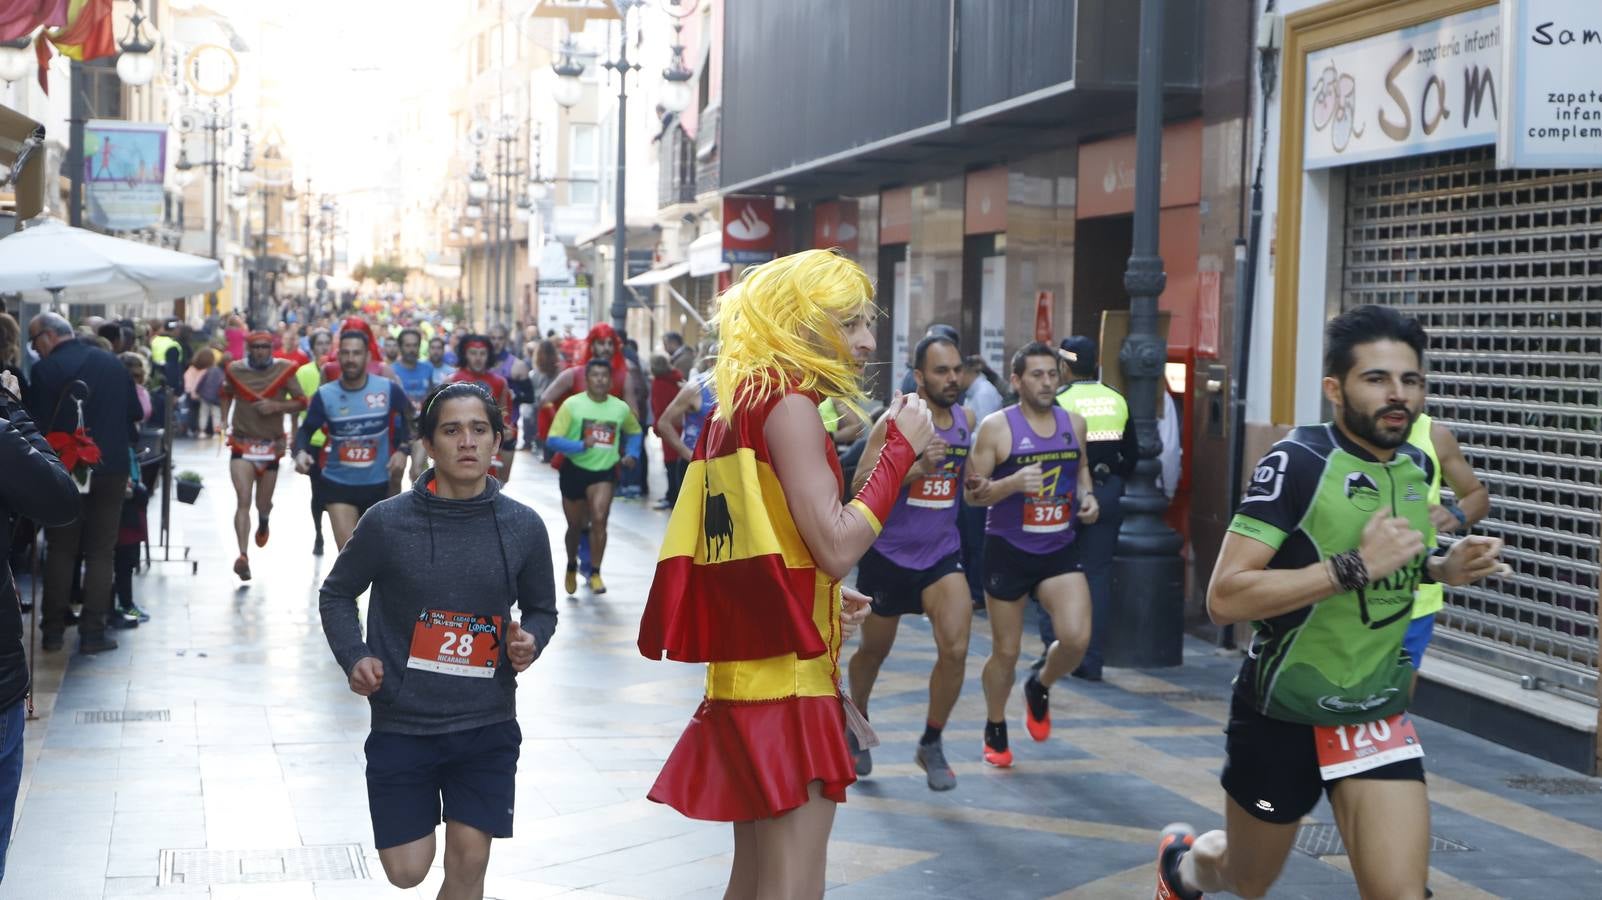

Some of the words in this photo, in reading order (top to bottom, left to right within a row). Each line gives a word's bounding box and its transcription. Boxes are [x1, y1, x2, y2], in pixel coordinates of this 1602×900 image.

[1464, 26, 1500, 53] infantil
[1532, 22, 1602, 45] Sam
[1378, 46, 1498, 141] Sam
[1557, 107, 1601, 120] infan
[1528, 125, 1602, 142] complem
[346, 448, 370, 459] 472
[922, 480, 951, 496] 558
[1034, 505, 1063, 521] 376
[468, 623, 496, 633] LORCA
[440, 632, 474, 657] 28
[437, 655, 470, 665] NICARAGUA
[1335, 719, 1391, 751] 120
